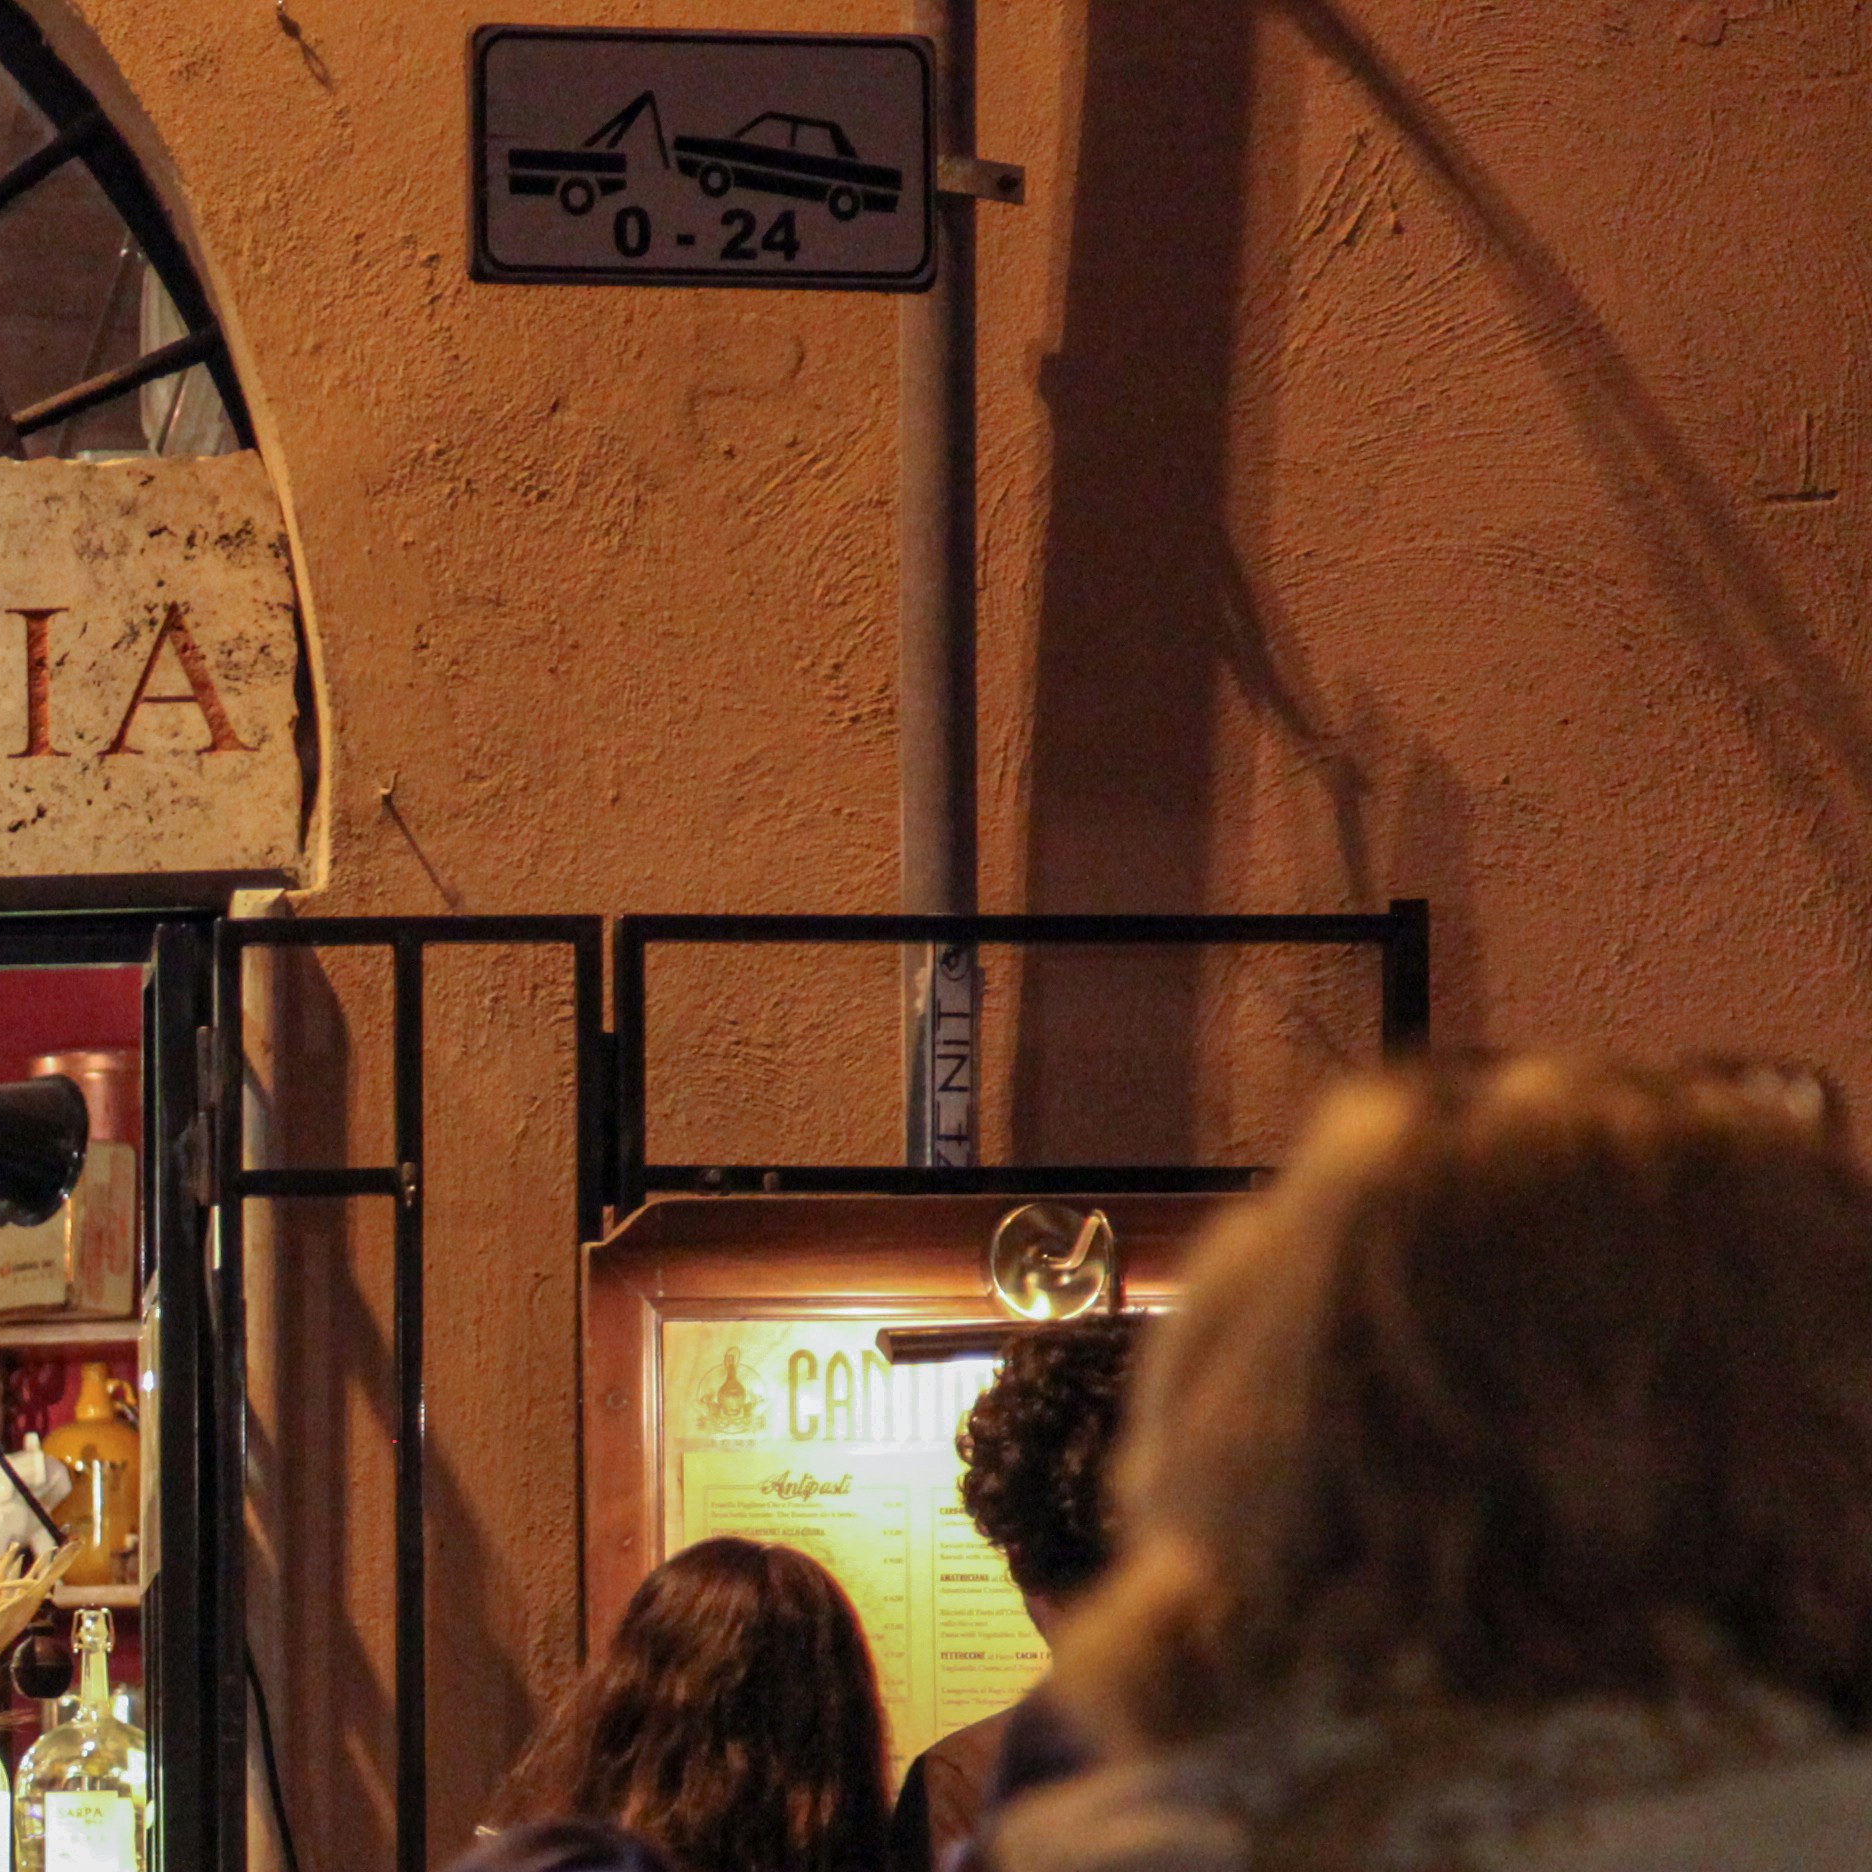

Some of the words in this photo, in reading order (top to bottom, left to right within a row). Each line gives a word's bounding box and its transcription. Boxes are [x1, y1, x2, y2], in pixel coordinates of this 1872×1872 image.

[613, 205, 652, 259] 0
[719, 208, 800, 262] 24
[758, 1469, 854, 1502] Antipasti
[58, 1806, 103, 1819] SARPA
